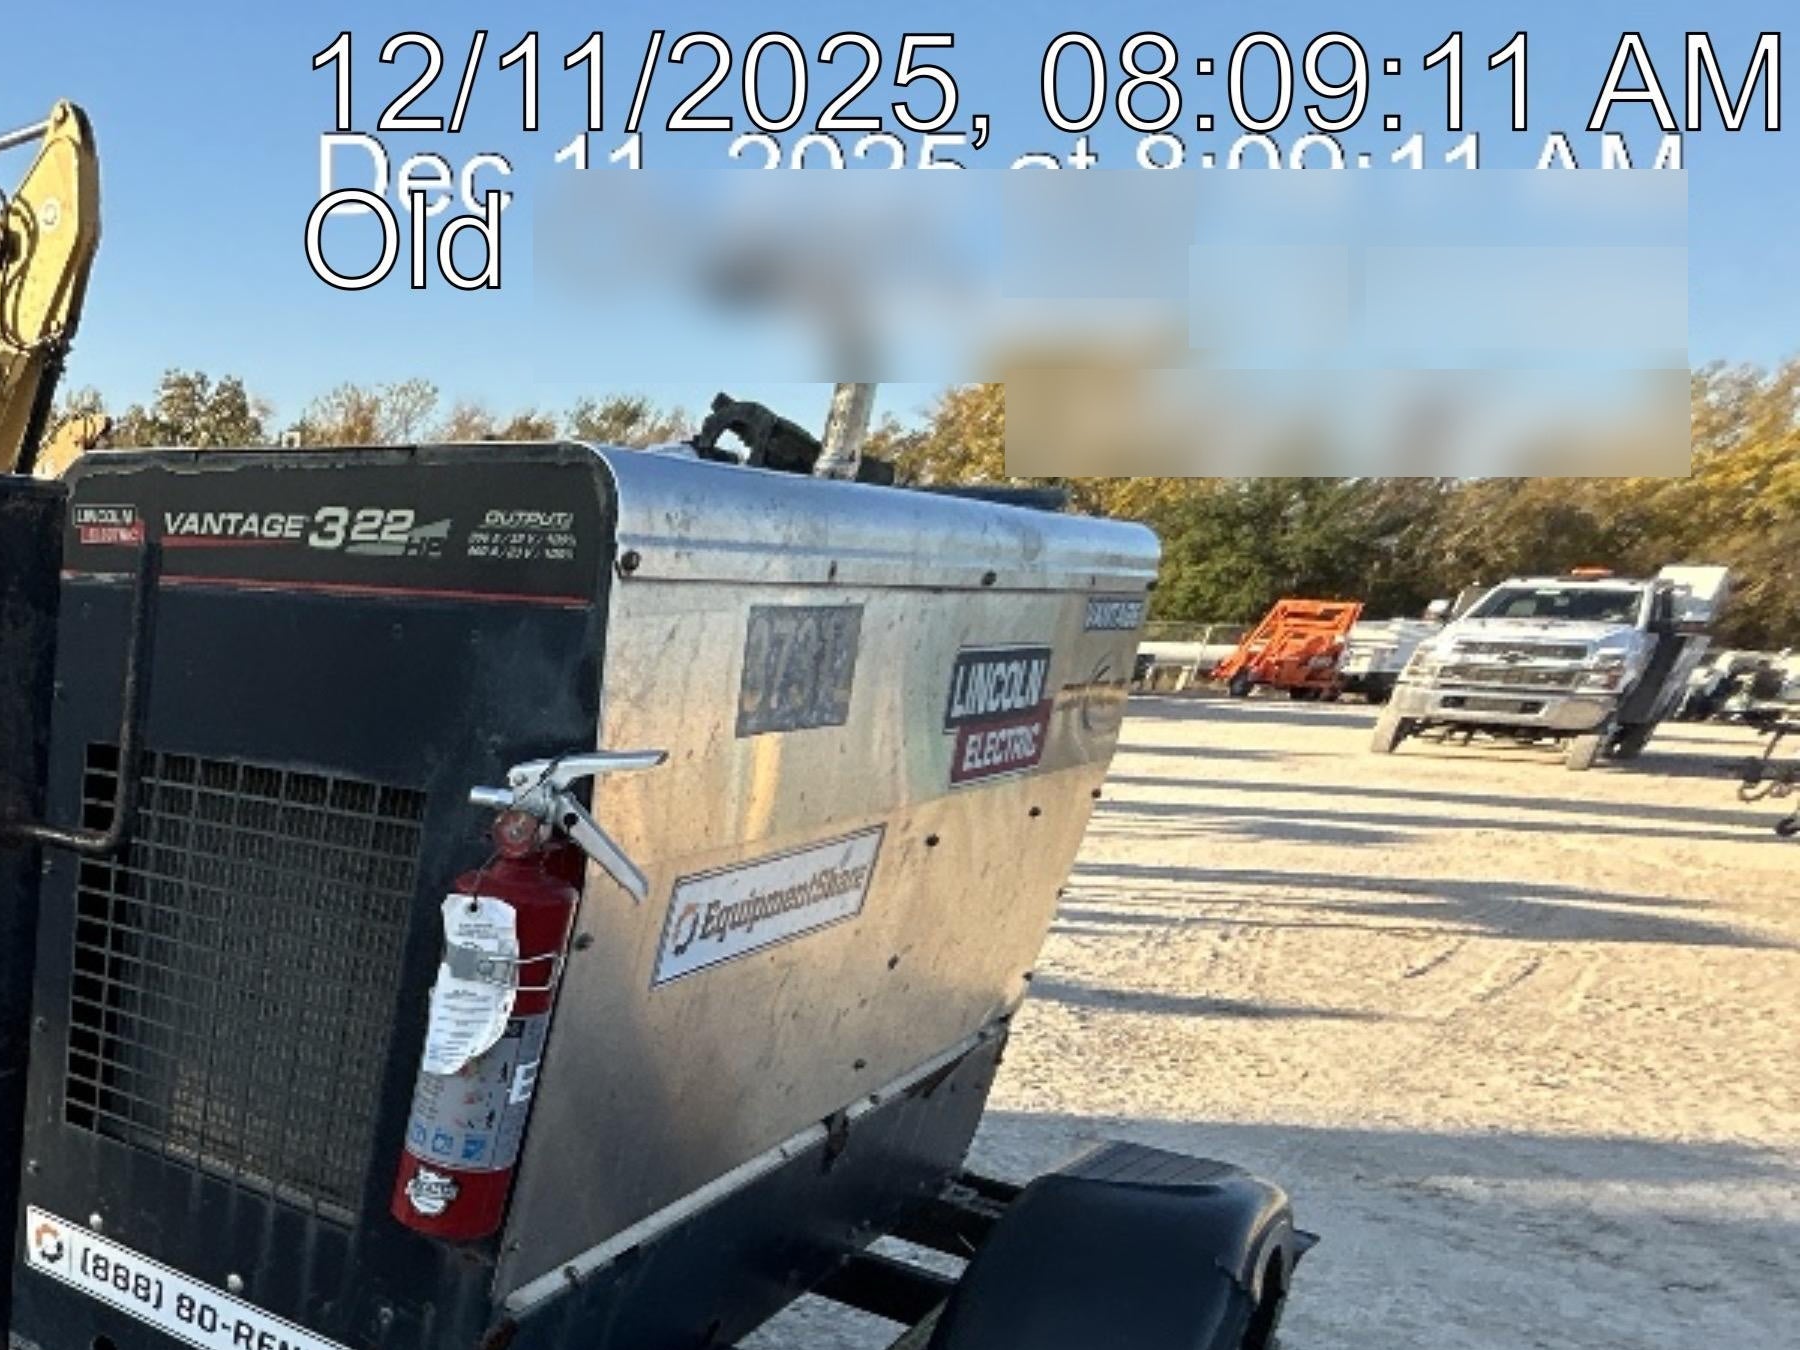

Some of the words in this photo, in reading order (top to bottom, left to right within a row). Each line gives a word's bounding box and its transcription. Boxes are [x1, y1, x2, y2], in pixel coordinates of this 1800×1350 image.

[163, 511, 304, 538] VANTAGE
[308, 506, 416, 549] 322
[951, 659, 1047, 718] LINCOLN
[962, 722, 1042, 772] ELECTRIC
[699, 865, 868, 942] EquipmentShare
[80, 1246, 164, 1311] (888)
